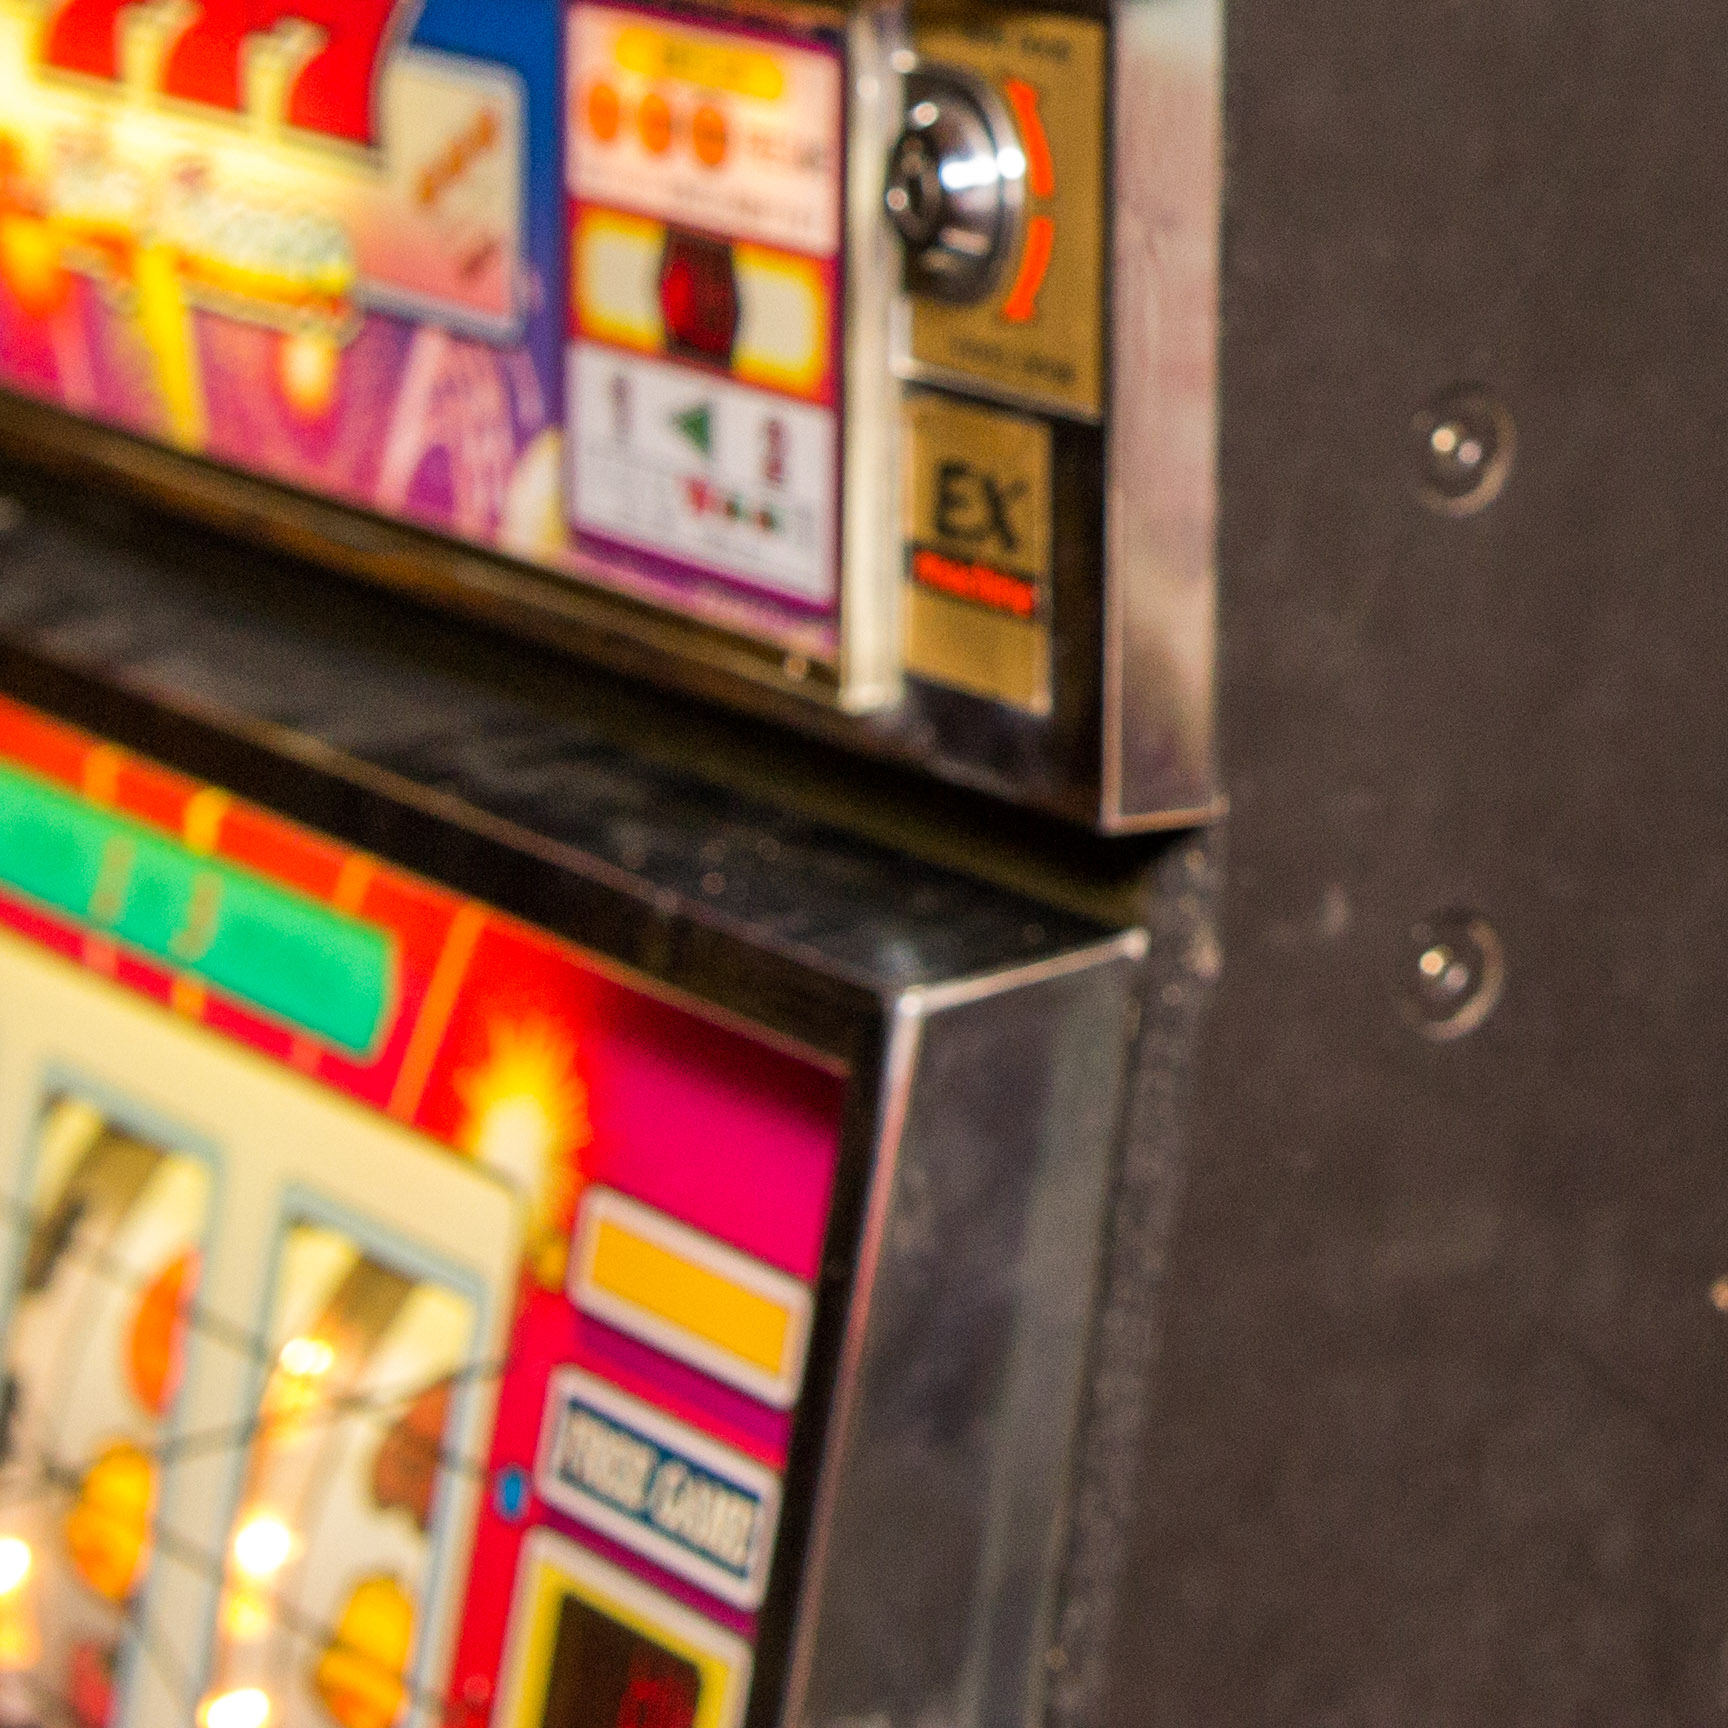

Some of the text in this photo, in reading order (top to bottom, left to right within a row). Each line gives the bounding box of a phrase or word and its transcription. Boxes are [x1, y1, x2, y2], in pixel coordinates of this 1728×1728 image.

[934, 458, 1029, 551] EX
[560, 1410, 755, 1566] FREE GAME
